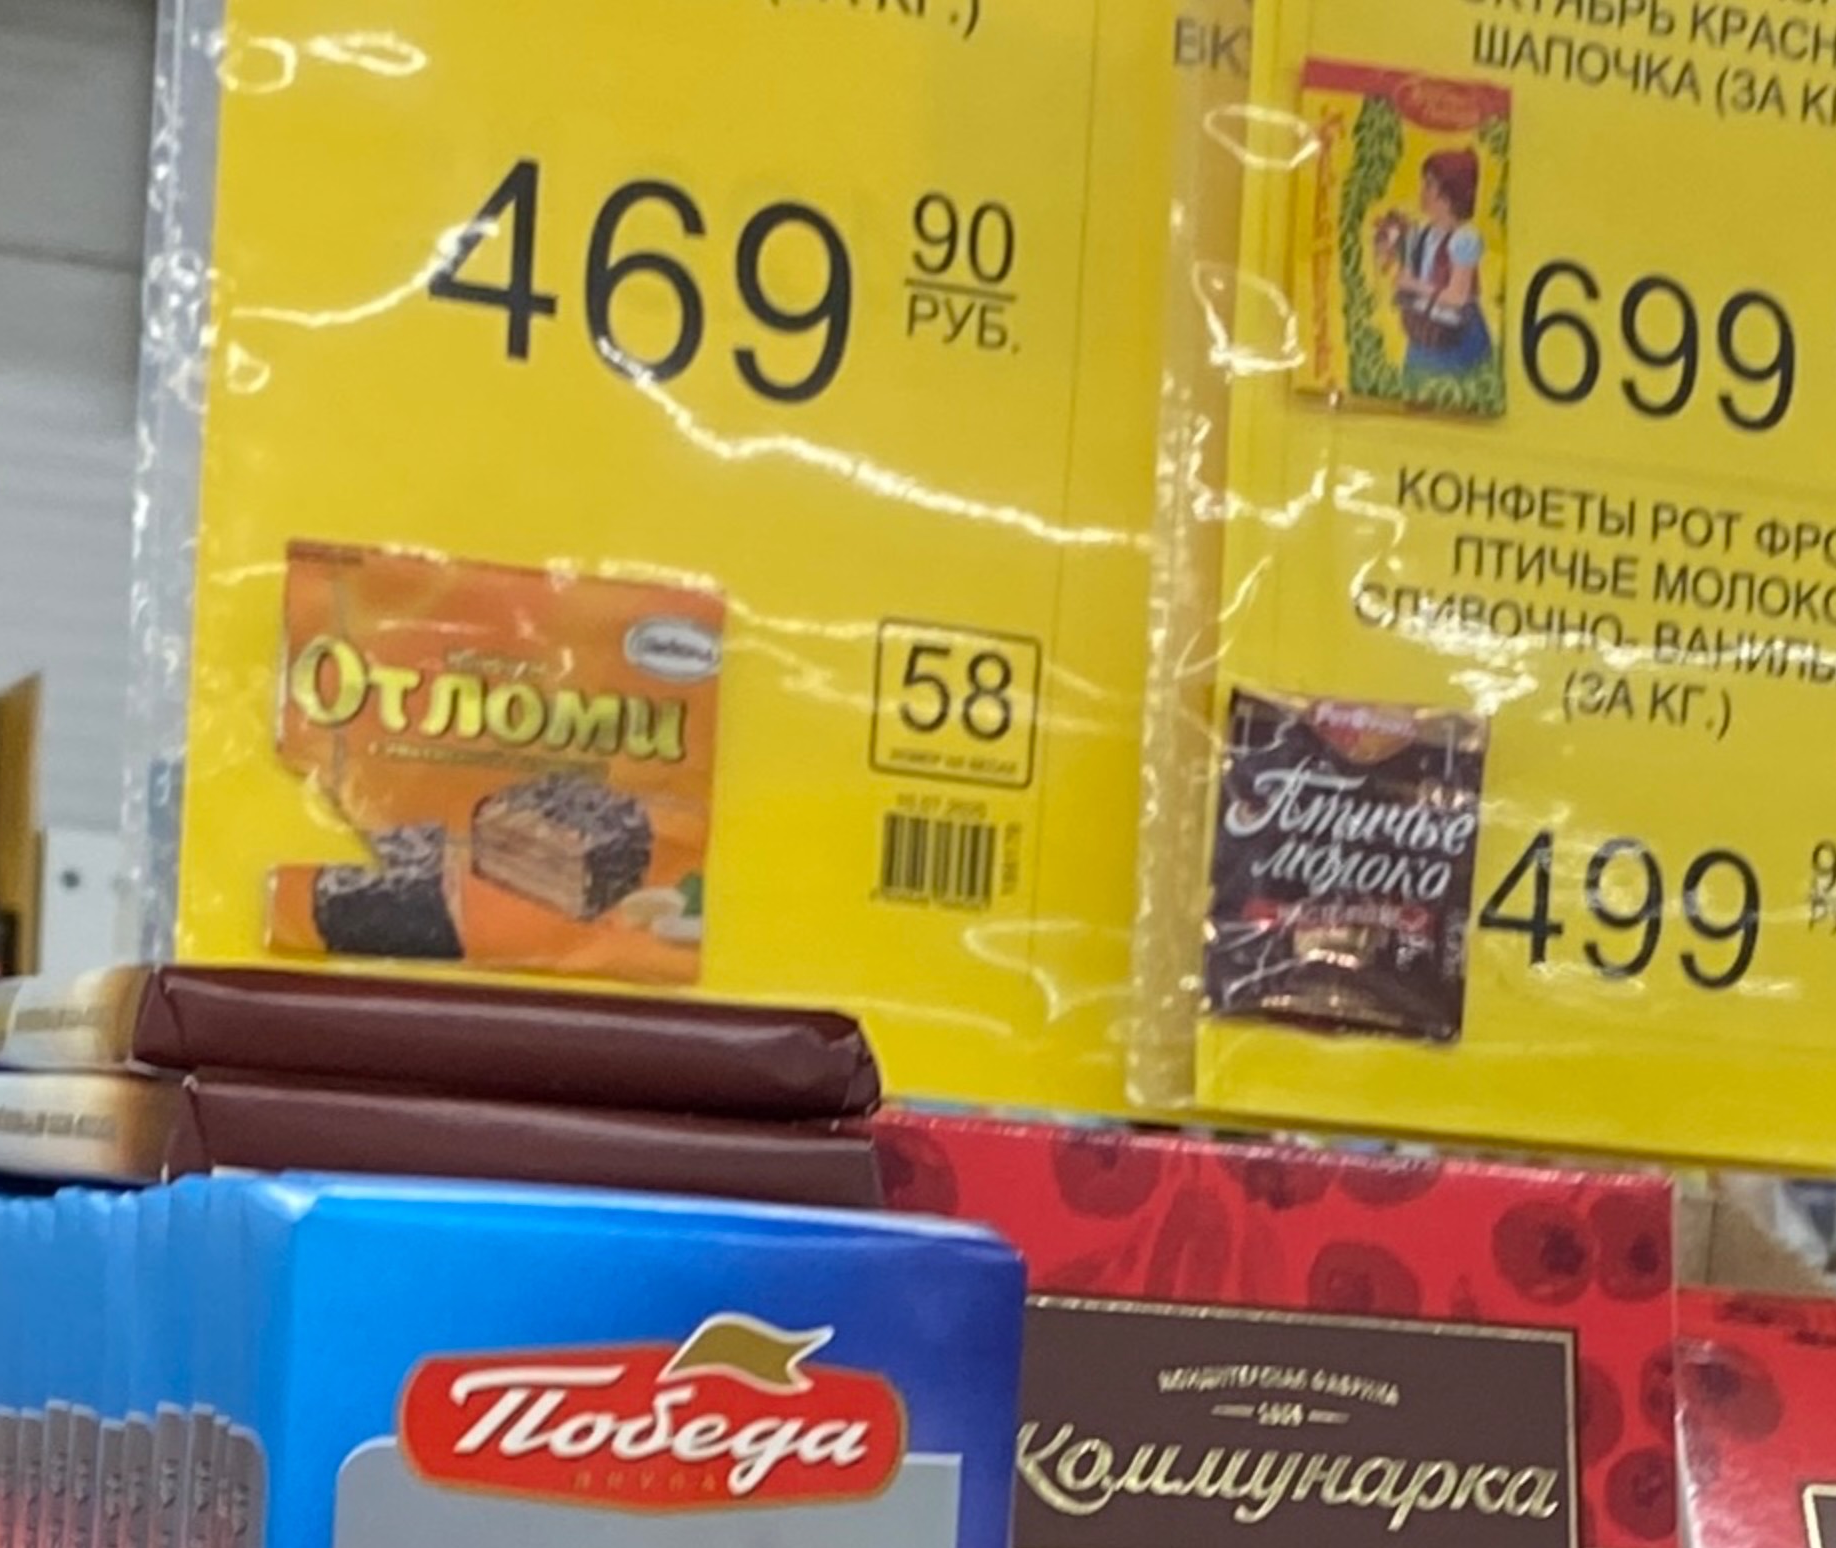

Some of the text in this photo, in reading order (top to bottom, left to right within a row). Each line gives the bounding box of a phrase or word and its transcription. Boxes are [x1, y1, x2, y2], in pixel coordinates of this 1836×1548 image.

[1473, 23, 1702, 105] ШАПОЧКА
[1716, 67, 1787, 118] (ЗА
[427, 158, 852, 404] 469
[911, 193, 1016, 285] 90
[905, 297, 1020, 354] РУБ.
[1522, 259, 1797, 431] 699
[1397, 466, 1638, 540] КОНФЕТЫ
[1650, 500, 1741, 558] РОТ
[1453, 534, 1639, 599] ПТИЧЬЕ
[898, 645, 1015, 744] 58
[1563, 670, 1734, 742] (ЗА КГ.)
[1478, 829, 1760, 992] 499
[449, 1364, 871, 1498] Победа
[1014, 1420, 1561, 1530] Коммунарка
